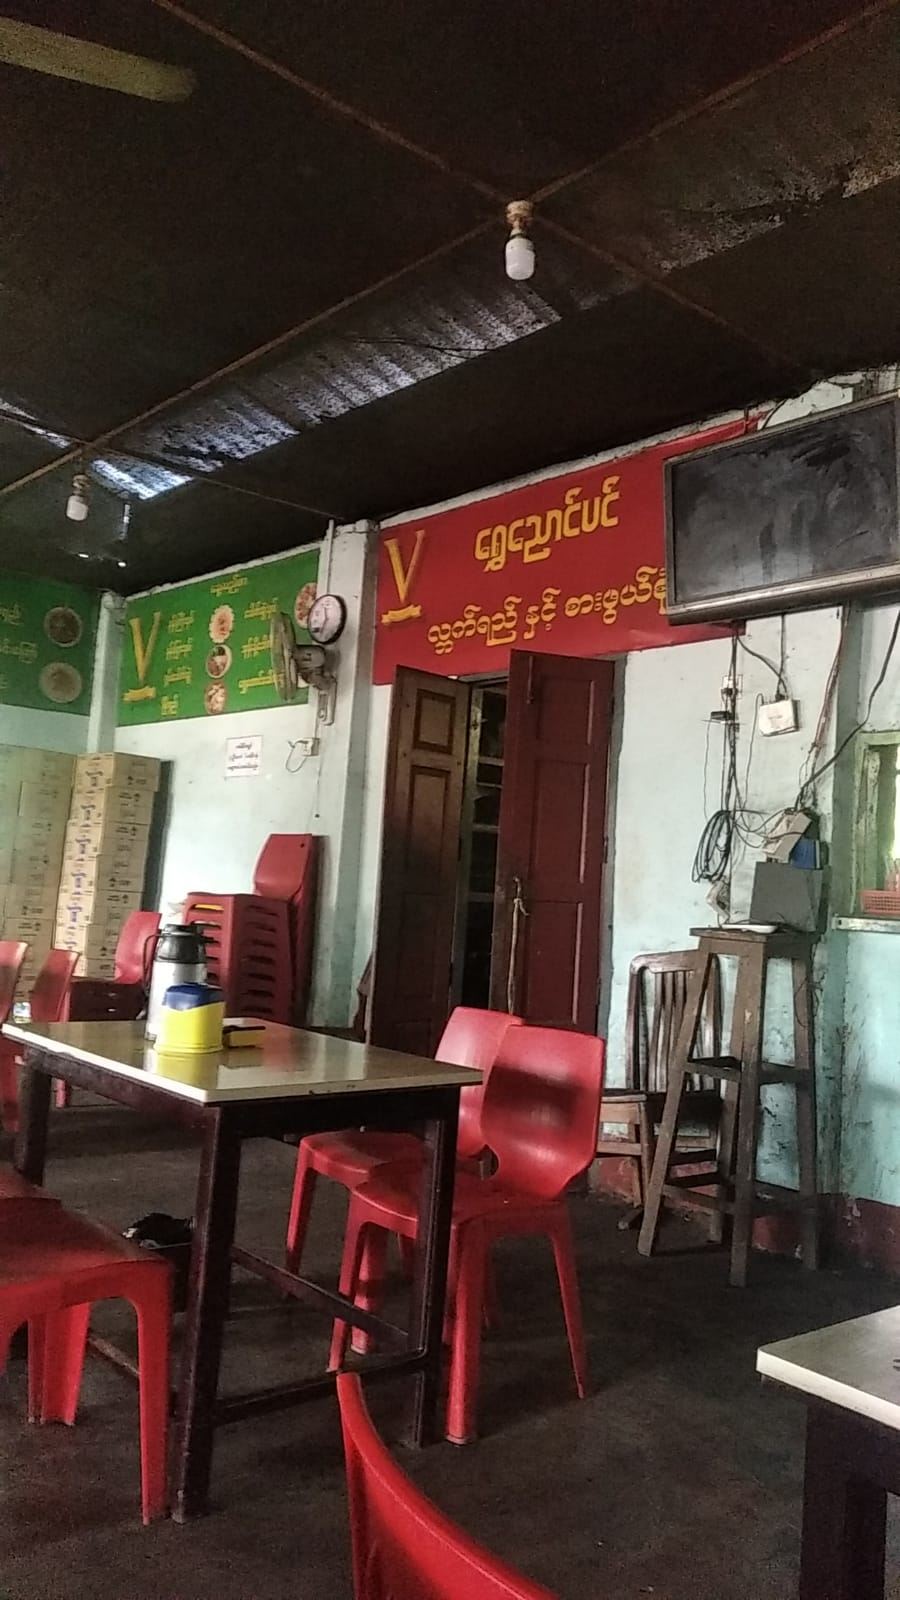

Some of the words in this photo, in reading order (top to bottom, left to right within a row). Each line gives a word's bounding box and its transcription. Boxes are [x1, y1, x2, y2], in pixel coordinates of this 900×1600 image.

[475, 475, 621, 573] ရွှေညောင်ပင်
[523, 587, 561, 639] နှင့်
